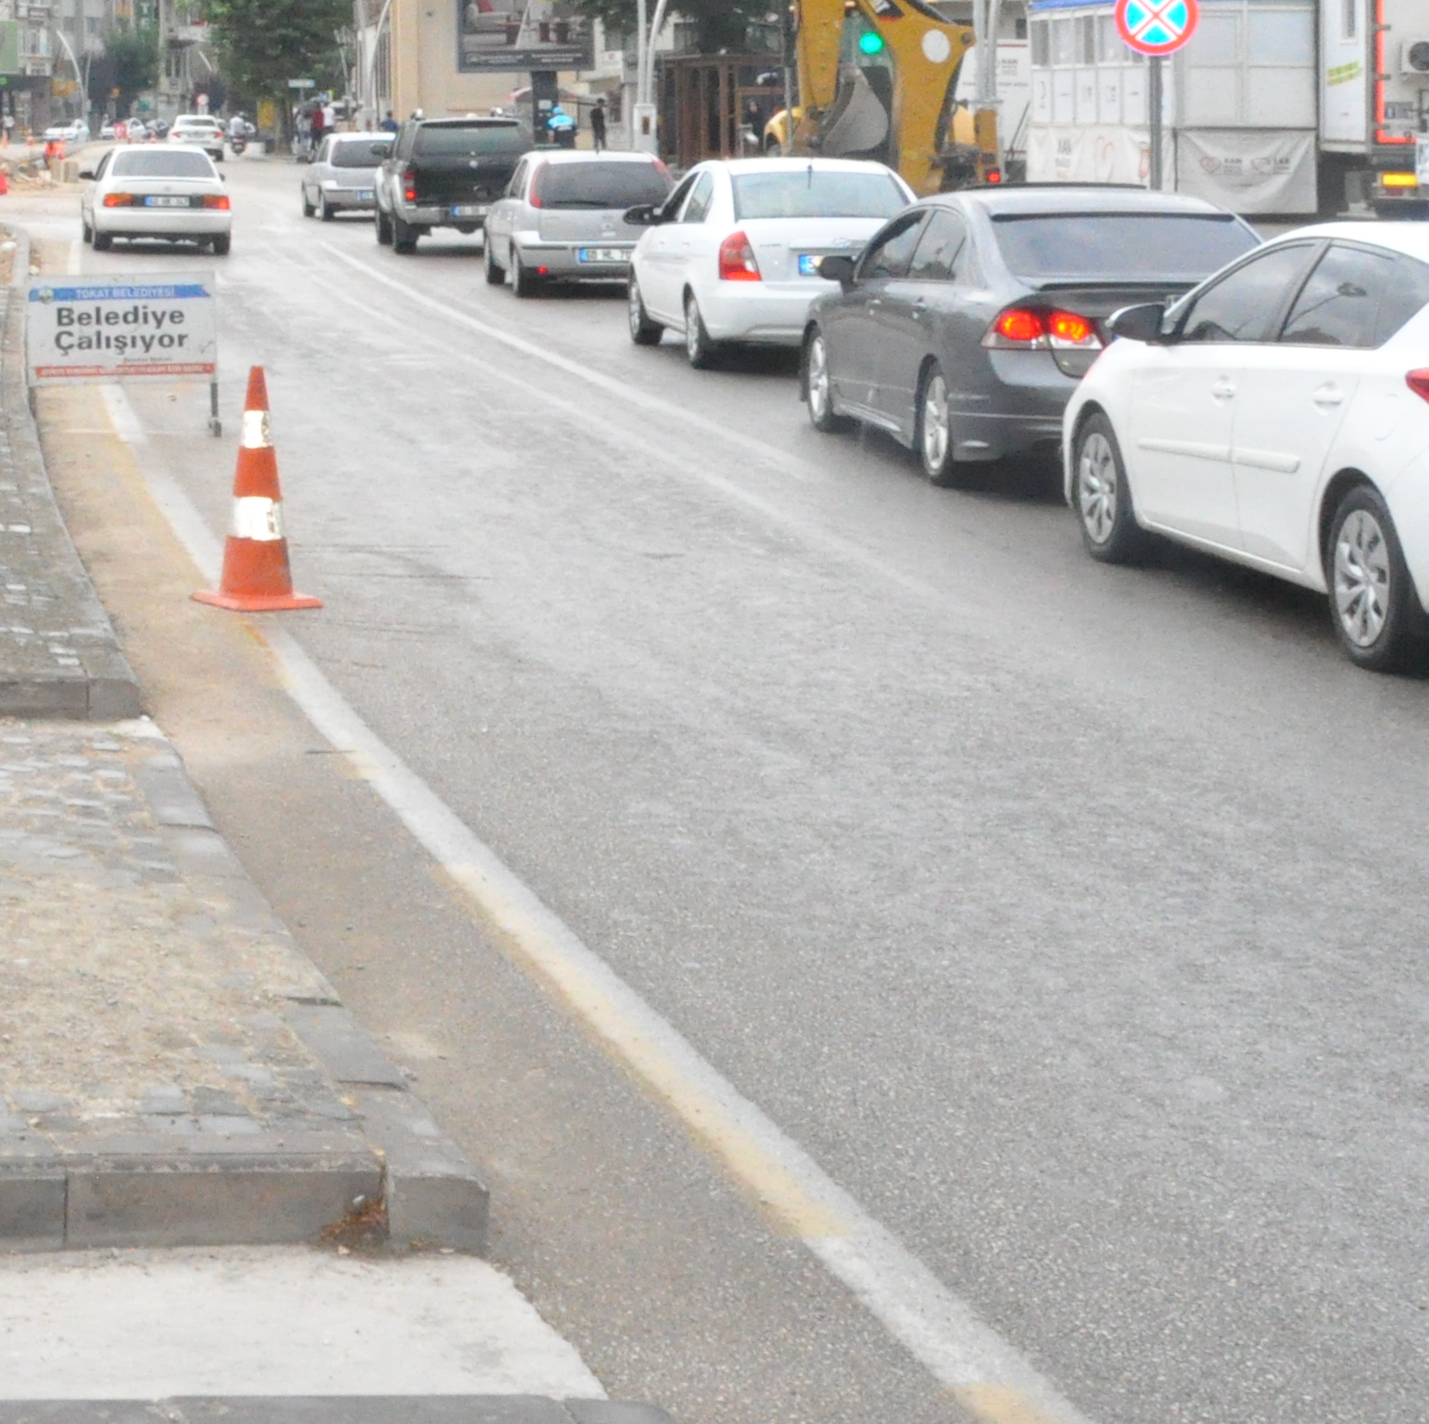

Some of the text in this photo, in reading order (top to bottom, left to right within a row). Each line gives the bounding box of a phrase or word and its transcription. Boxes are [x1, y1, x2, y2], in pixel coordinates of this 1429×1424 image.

[76, 287, 175, 299] TOKAT BELEDİYESİ
[56, 305, 185, 329] Belediye
[54, 331, 189, 356] Çalışıyor
